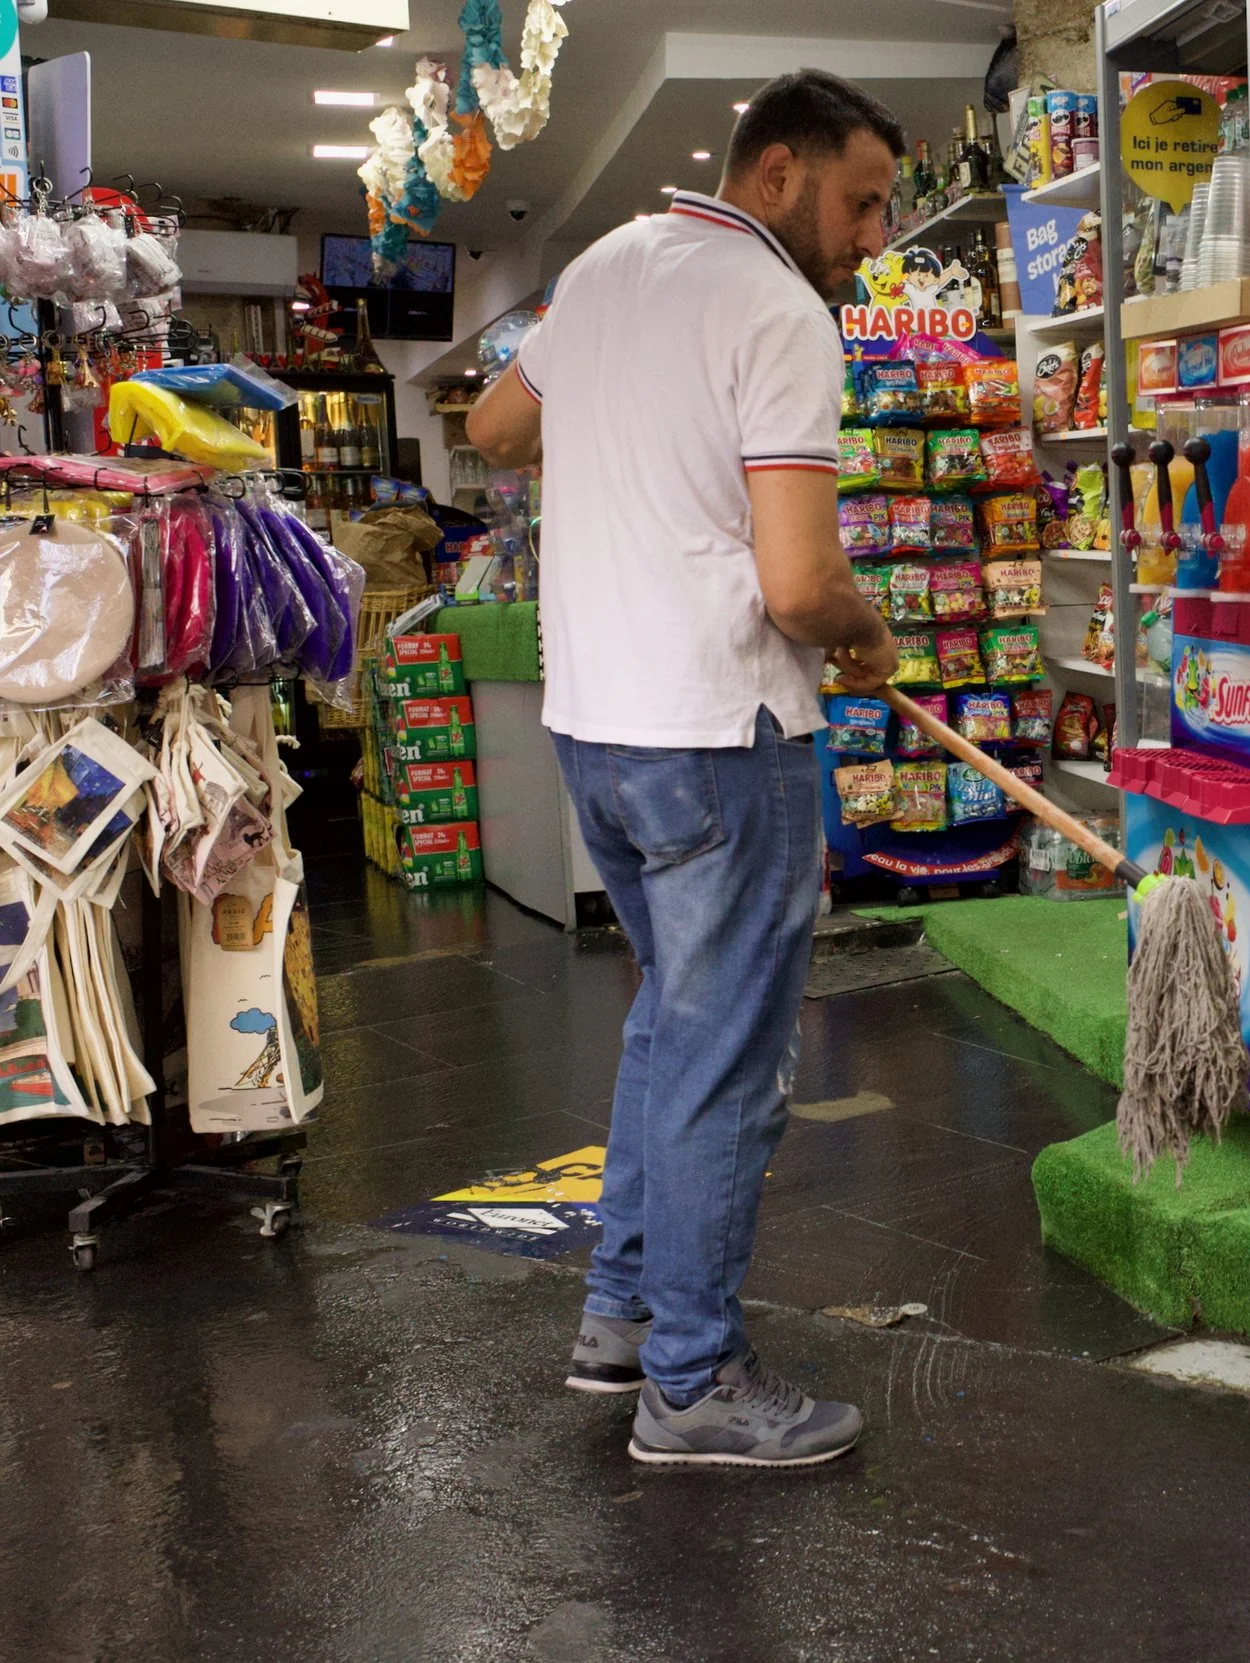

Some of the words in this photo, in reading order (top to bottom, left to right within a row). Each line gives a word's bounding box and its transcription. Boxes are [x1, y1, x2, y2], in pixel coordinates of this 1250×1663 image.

[1132, 136, 1150, 150] Ici
[1155, 136, 1168, 153] je
[1131, 160, 1164, 171] mon
[1169, 161, 1213, 176] argen
[1026, 218, 1056, 251] Bag
[1027, 235, 1071, 280] stora
[845, 307, 974, 339] HARIBO
[876, 369, 912, 380] HARIBO
[919, 369, 955, 381] HARIBO
[837, 436, 864, 445] ARIBO
[885, 436, 917, 446] HARIBO
[938, 436, 972, 446] HARIBO
[846, 504, 882, 514] HARIBO
[893, 504, 929, 514] HARIBO
[931, 504, 968, 513] HARIBO
[1001, 502, 1030, 510] HARIBO
[873, 513, 886, 521] PIK
[895, 573, 926, 581] HARIBO
[936, 571, 969, 580] HARIBO
[1000, 568, 1034, 577] HARIBO
[855, 575, 882, 583] ARIBO
[943, 638, 972, 649] HARIBO
[999, 635, 1032, 644] HARIBO
[967, 700, 1004, 709] HARIBO
[845, 706, 882, 719] HARIBO
[852, 774, 886, 783] HARIBO
[900, 771, 941, 780] HARIBO
[895, 860, 907, 871] la
[481, 1209, 555, 1228] Euronet
